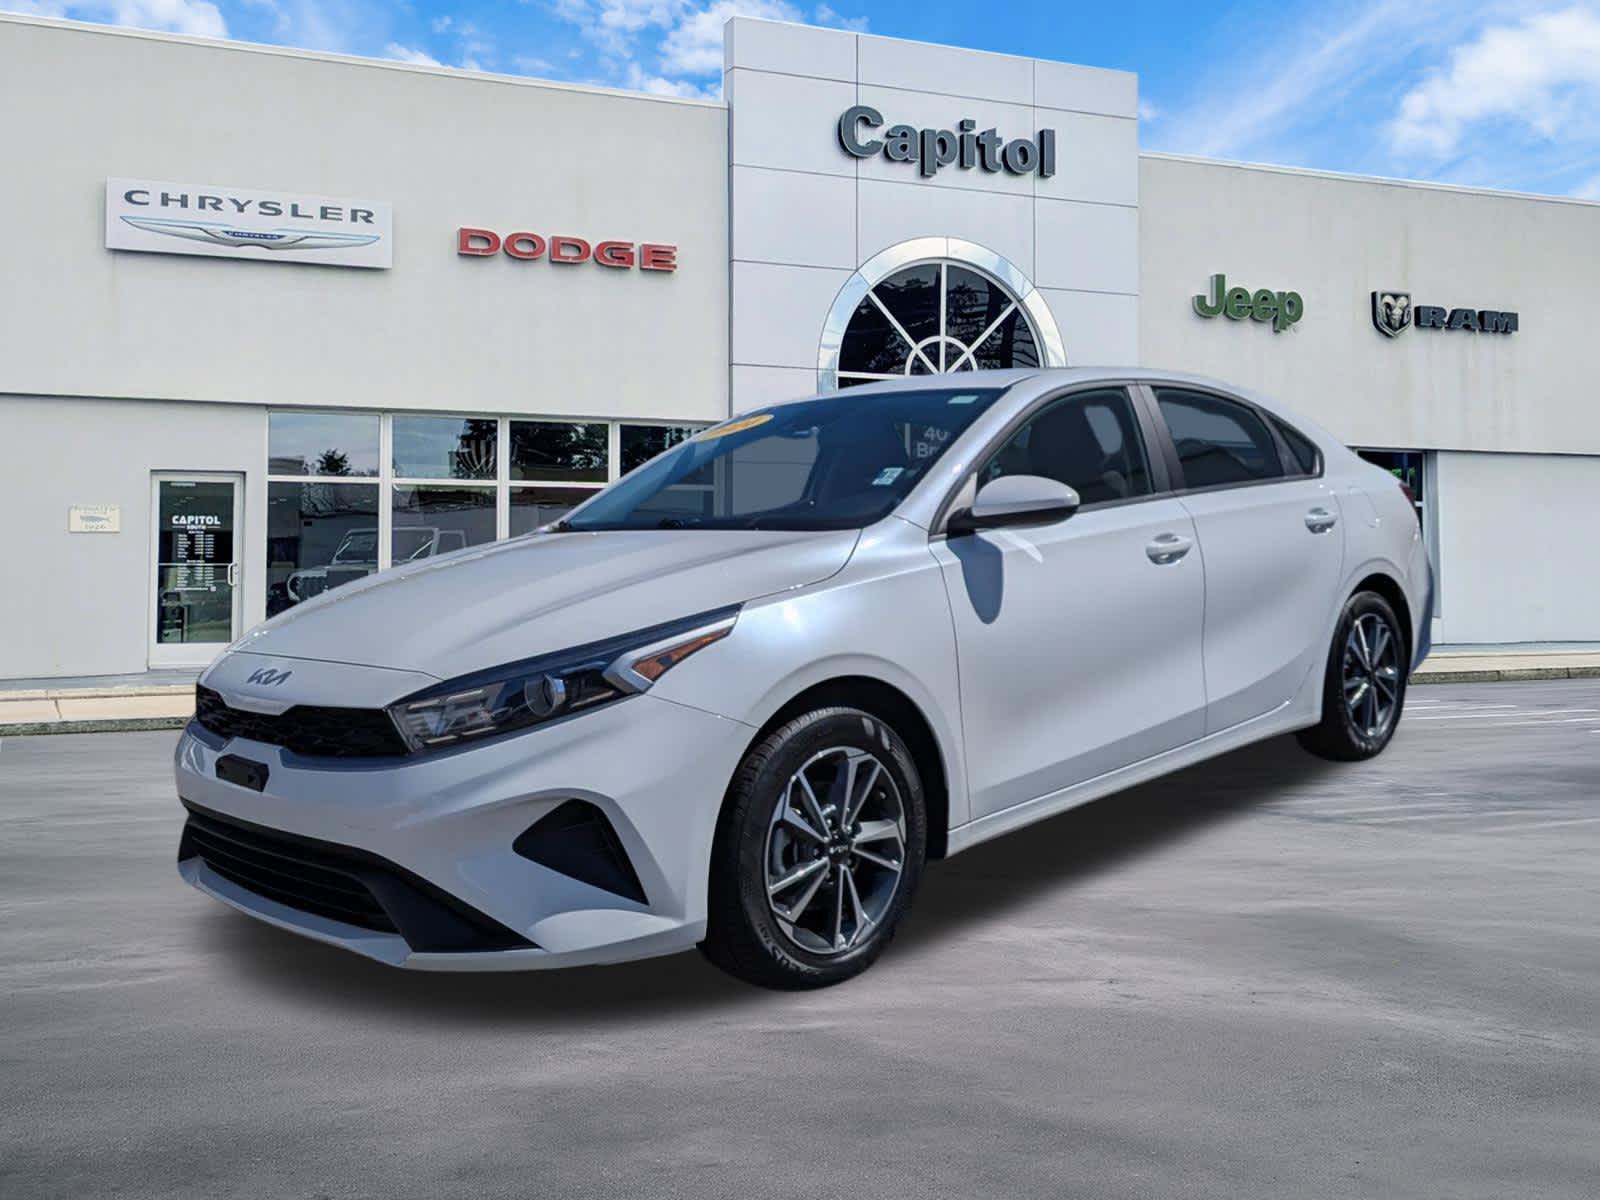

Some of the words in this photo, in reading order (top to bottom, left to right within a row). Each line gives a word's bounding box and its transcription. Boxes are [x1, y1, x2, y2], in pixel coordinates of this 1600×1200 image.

[838, 105, 1056, 179] Capitol
[124, 189, 375, 224] CHRYSLER
[457, 227, 678, 272] DODGE
[1192, 274, 1304, 333] Jeep
[1414, 305, 1519, 334] RAM
[172, 515, 221, 525] CAPITOL
